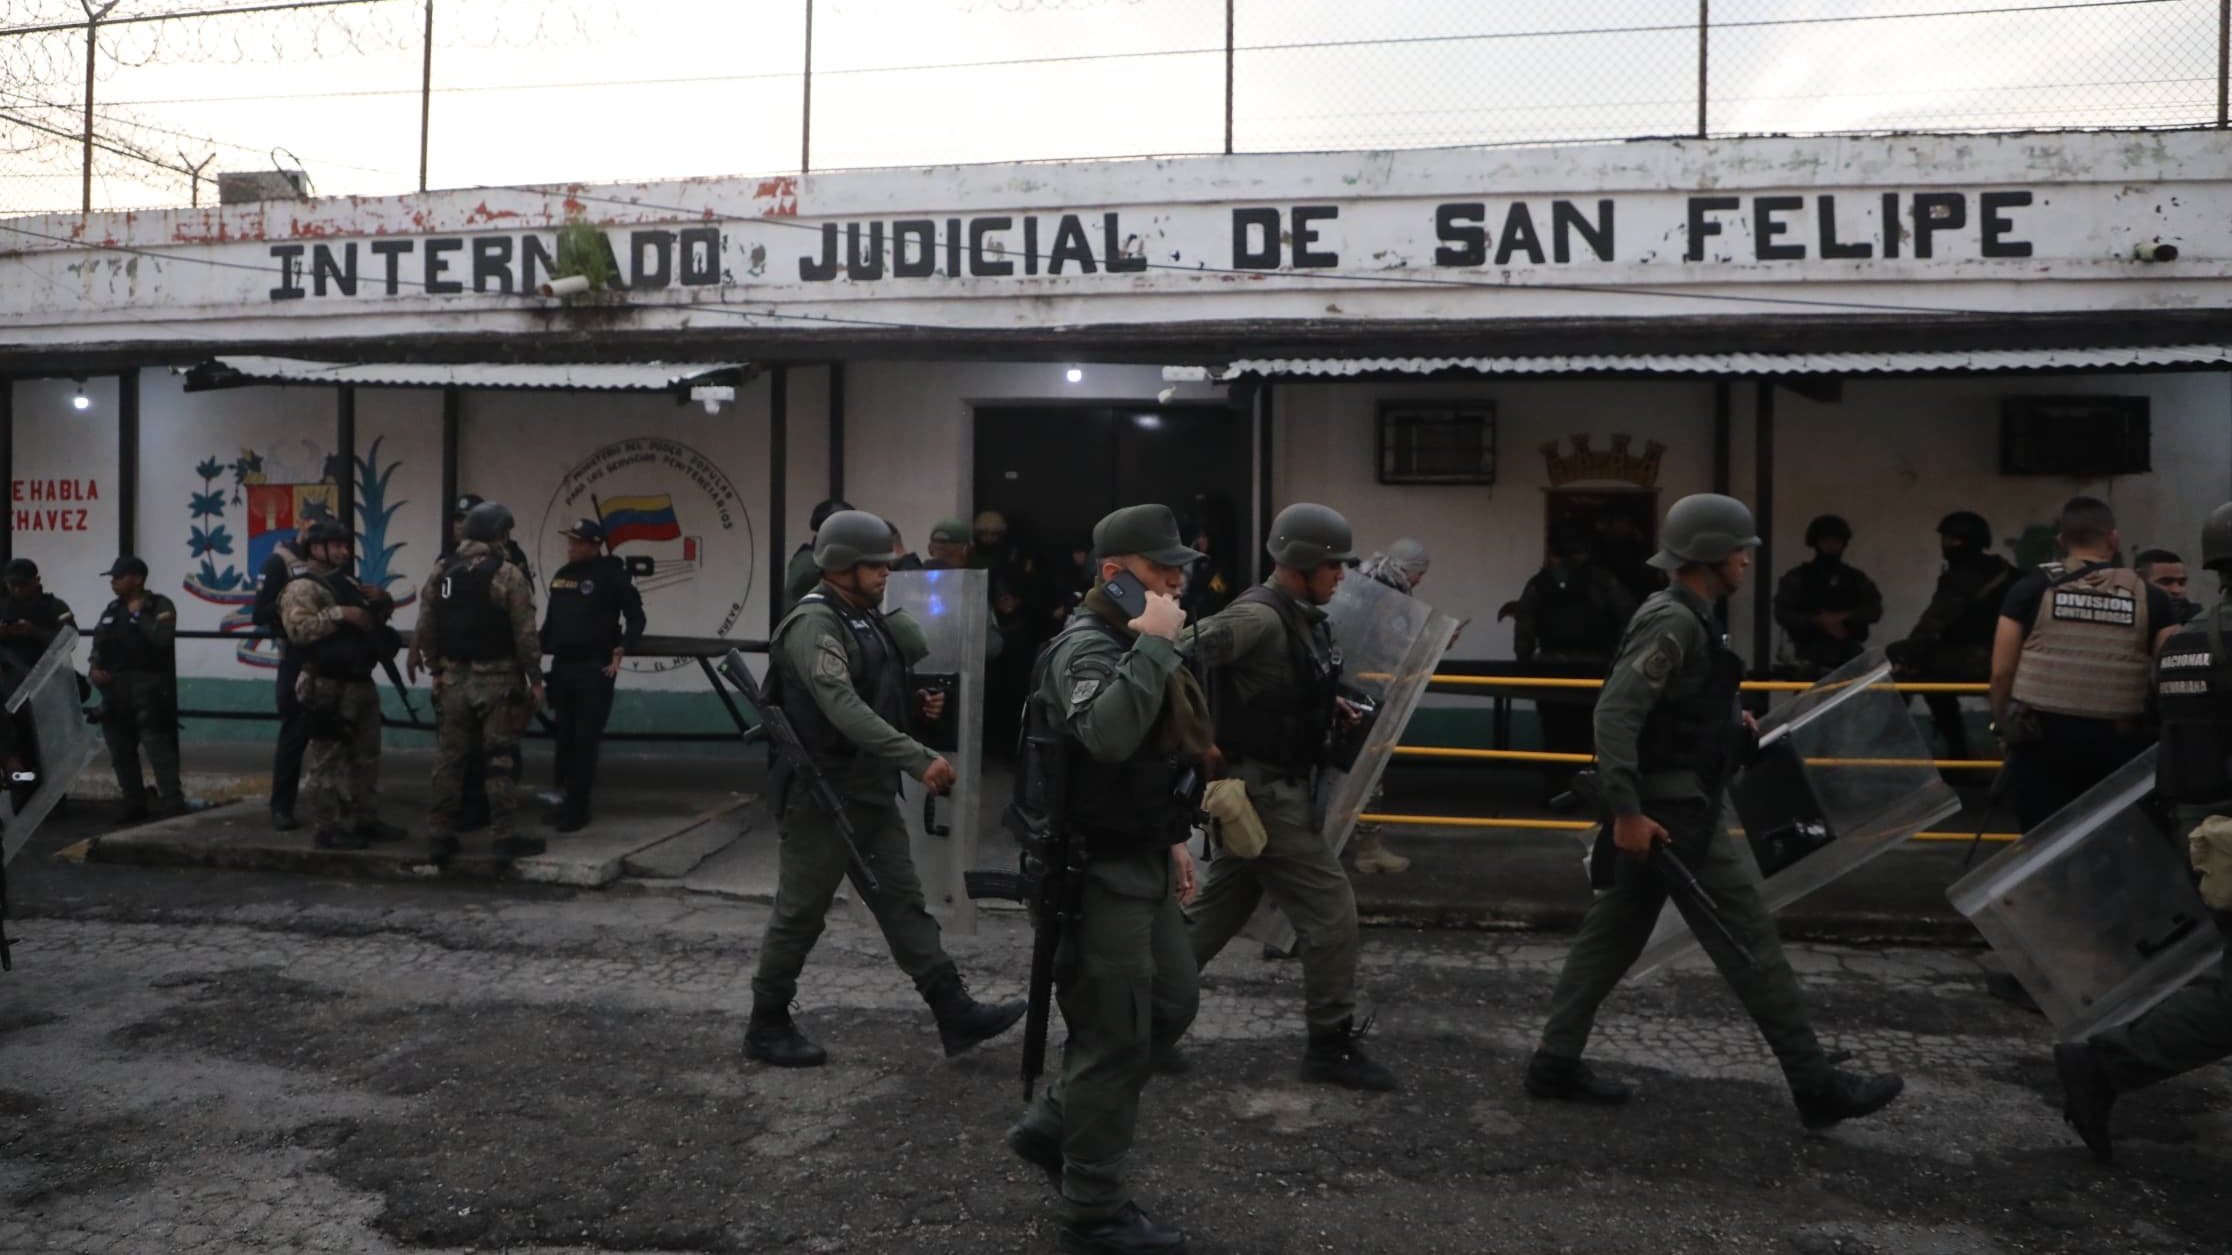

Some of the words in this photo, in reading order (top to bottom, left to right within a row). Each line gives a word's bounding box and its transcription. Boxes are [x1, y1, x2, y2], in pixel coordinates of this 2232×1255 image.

[800, 212, 1148, 281] JUDICIAL
[1232, 205, 1339, 270] DE
[1434, 200, 1615, 267] SAN
[1687, 191, 2034, 262] FELIPE
[30, 479, 98, 501] HABLA
[690, 455, 733, 500] POPULAR
[717, 602, 740, 637] NUEVO
[2056, 592, 2133, 612] DIVISION
